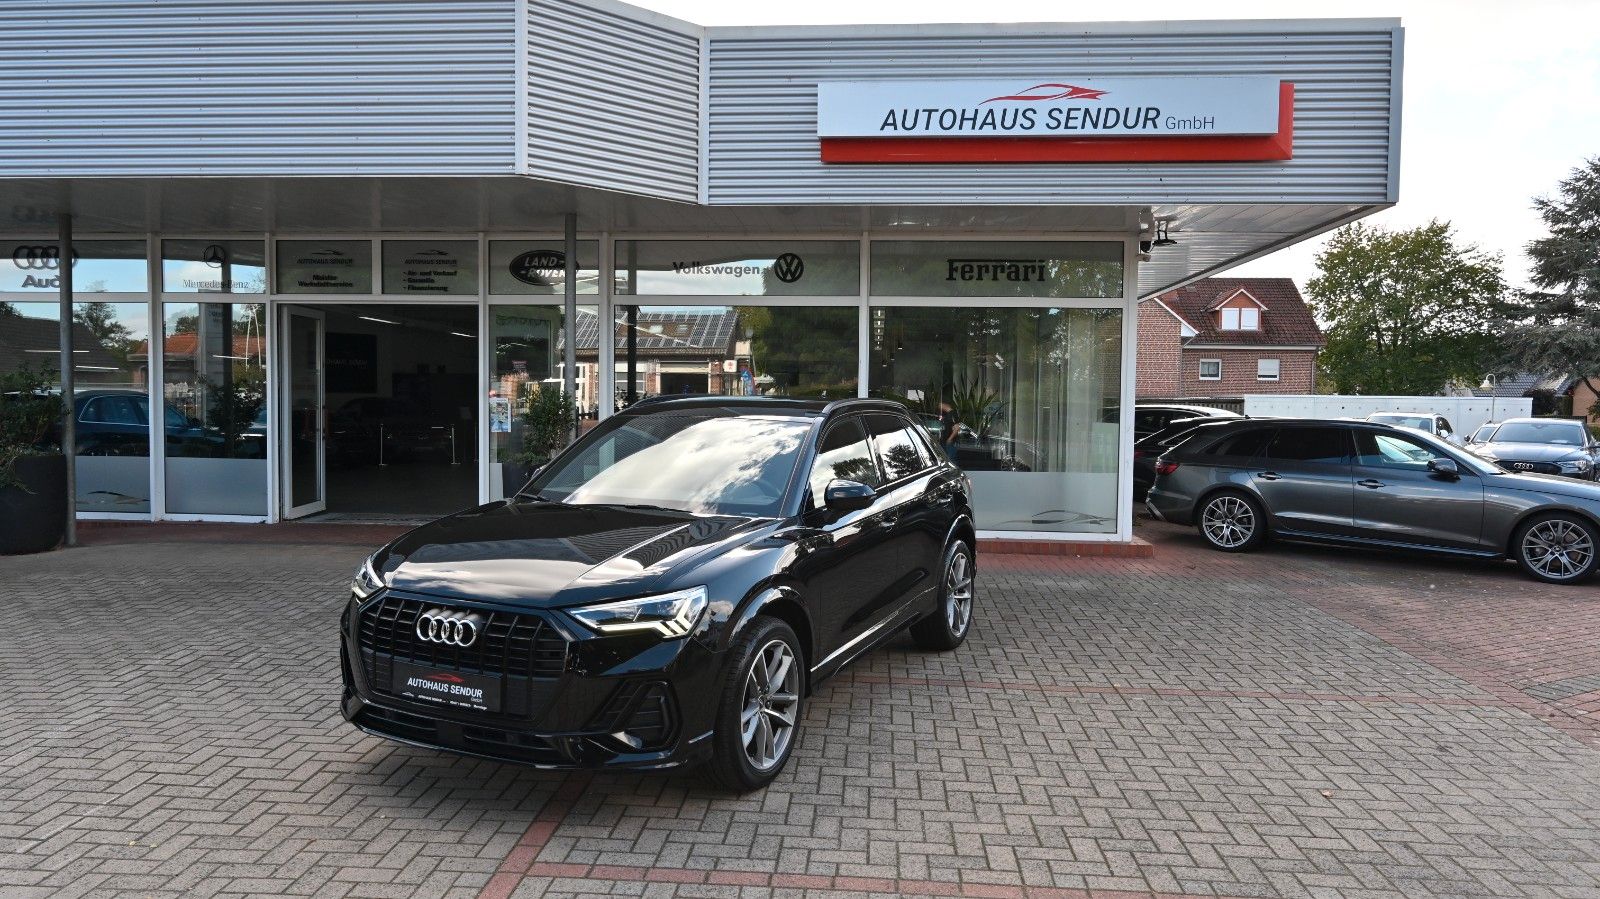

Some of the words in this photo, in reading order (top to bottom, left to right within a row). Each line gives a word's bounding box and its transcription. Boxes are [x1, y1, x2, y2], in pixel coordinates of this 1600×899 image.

[880, 107, 1038, 131] AUTOHAUS
[1044, 107, 1161, 131] SENDUR
[1164, 115, 1216, 131] GmbH
[671, 261, 761, 278] Volkswagen
[946, 258, 1047, 282] Ferrari
[21, 274, 62, 289] Aud
[407, 677, 449, 692] AUTOHAUS
[450, 684, 483, 698] SENDUR
